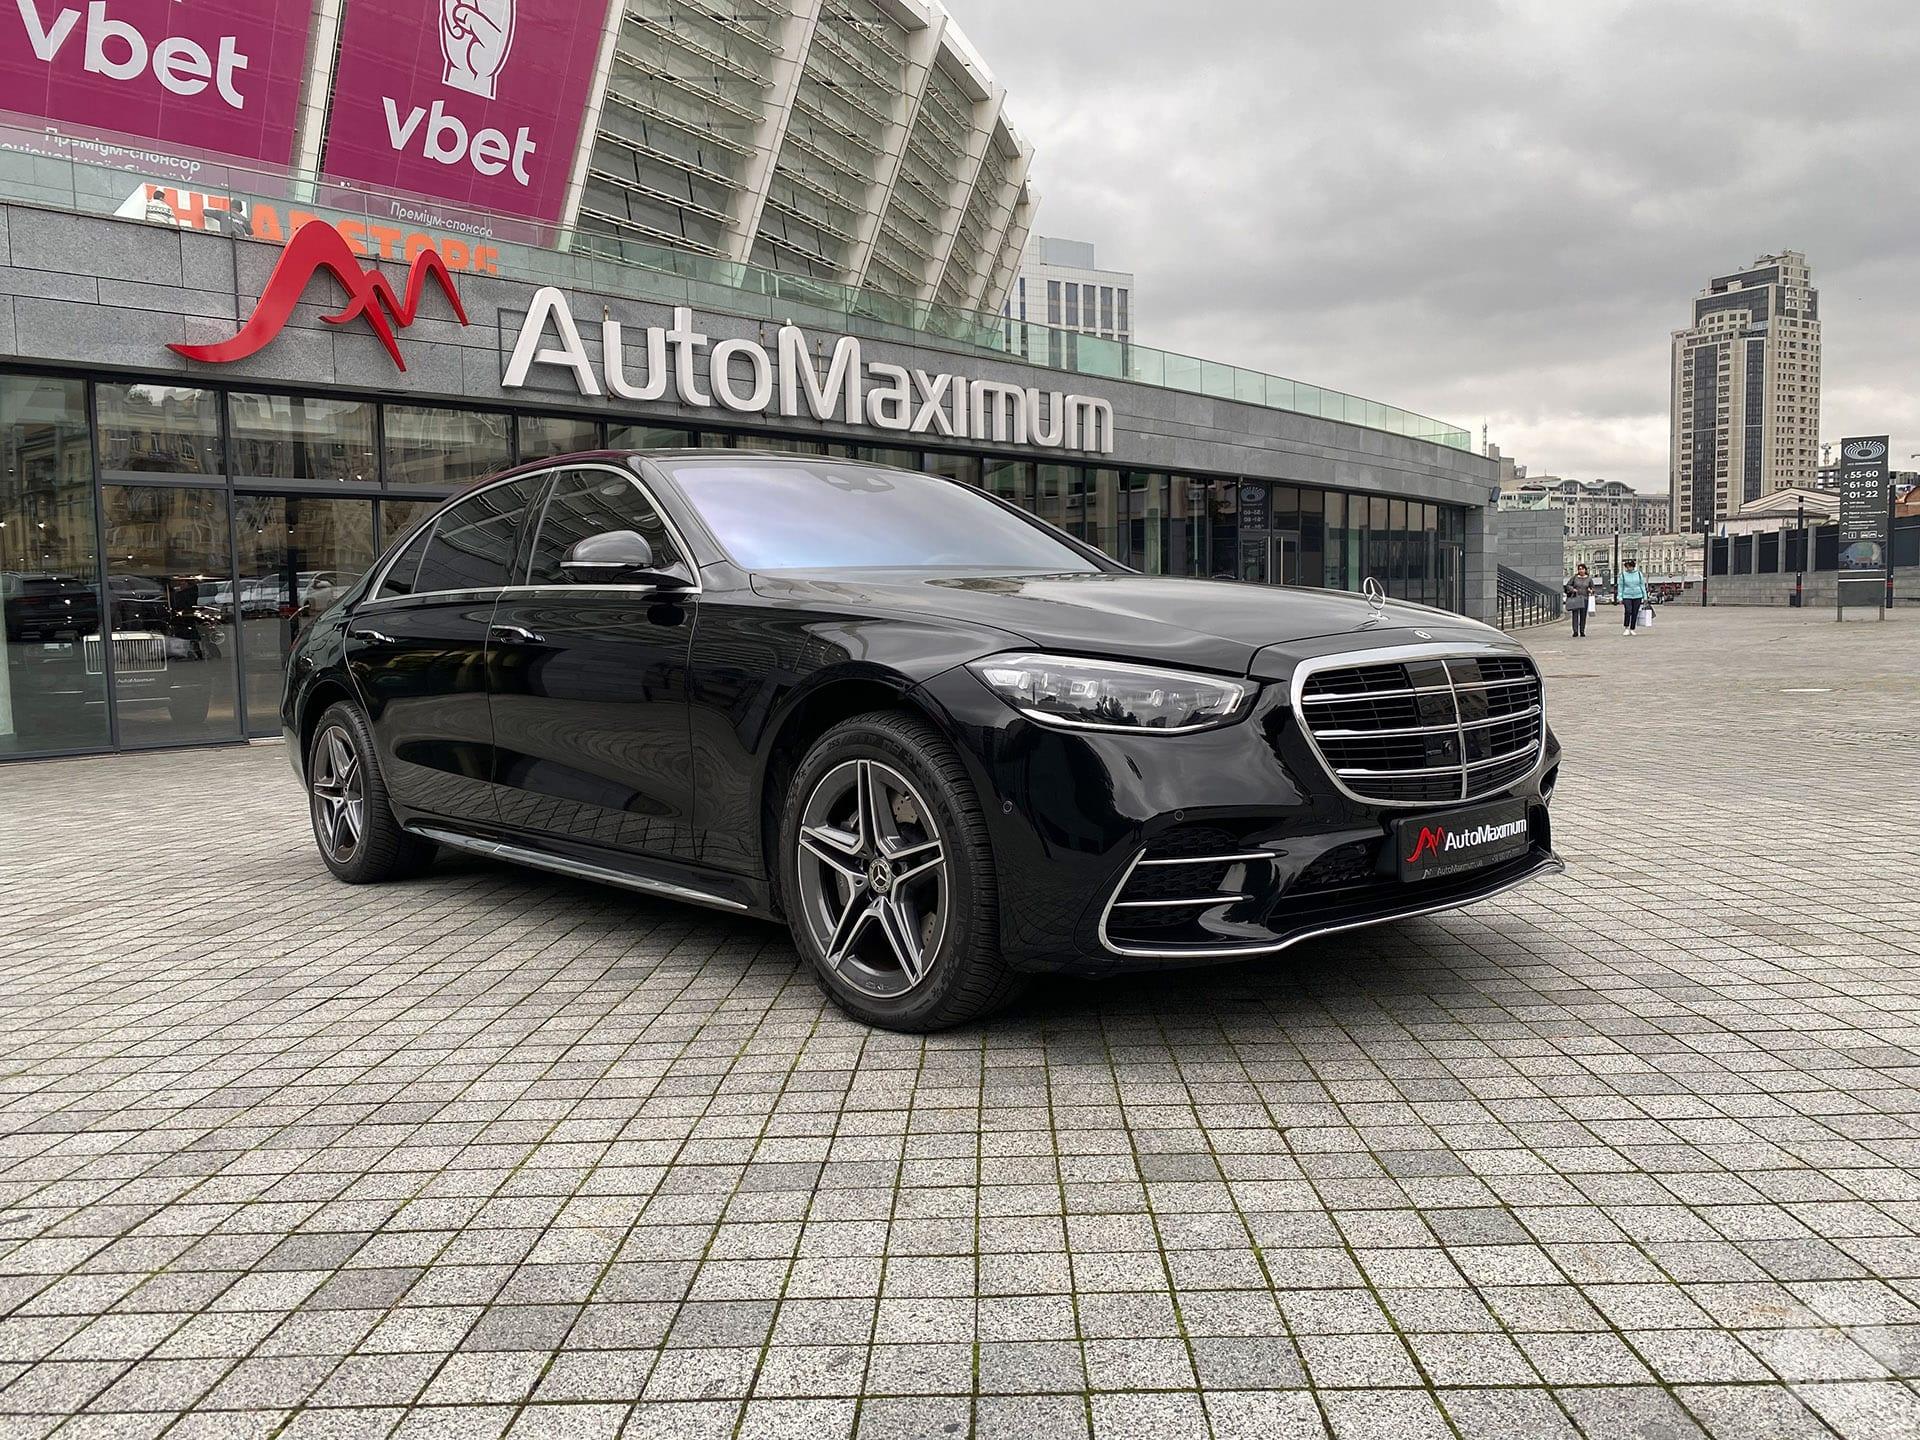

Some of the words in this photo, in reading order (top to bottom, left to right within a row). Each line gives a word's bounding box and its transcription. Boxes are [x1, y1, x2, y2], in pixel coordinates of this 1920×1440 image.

[16, 0, 249, 110] vbet
[382, 96, 537, 187] vbet
[501, 286, 1115, 454] AutoMaximum
[1849, 480, 1879, 489] 61-80
[1850, 470, 1879, 479] 55-60
[1849, 490, 1879, 499] 01-22
[1444, 818, 1527, 852] AutoMaximum
